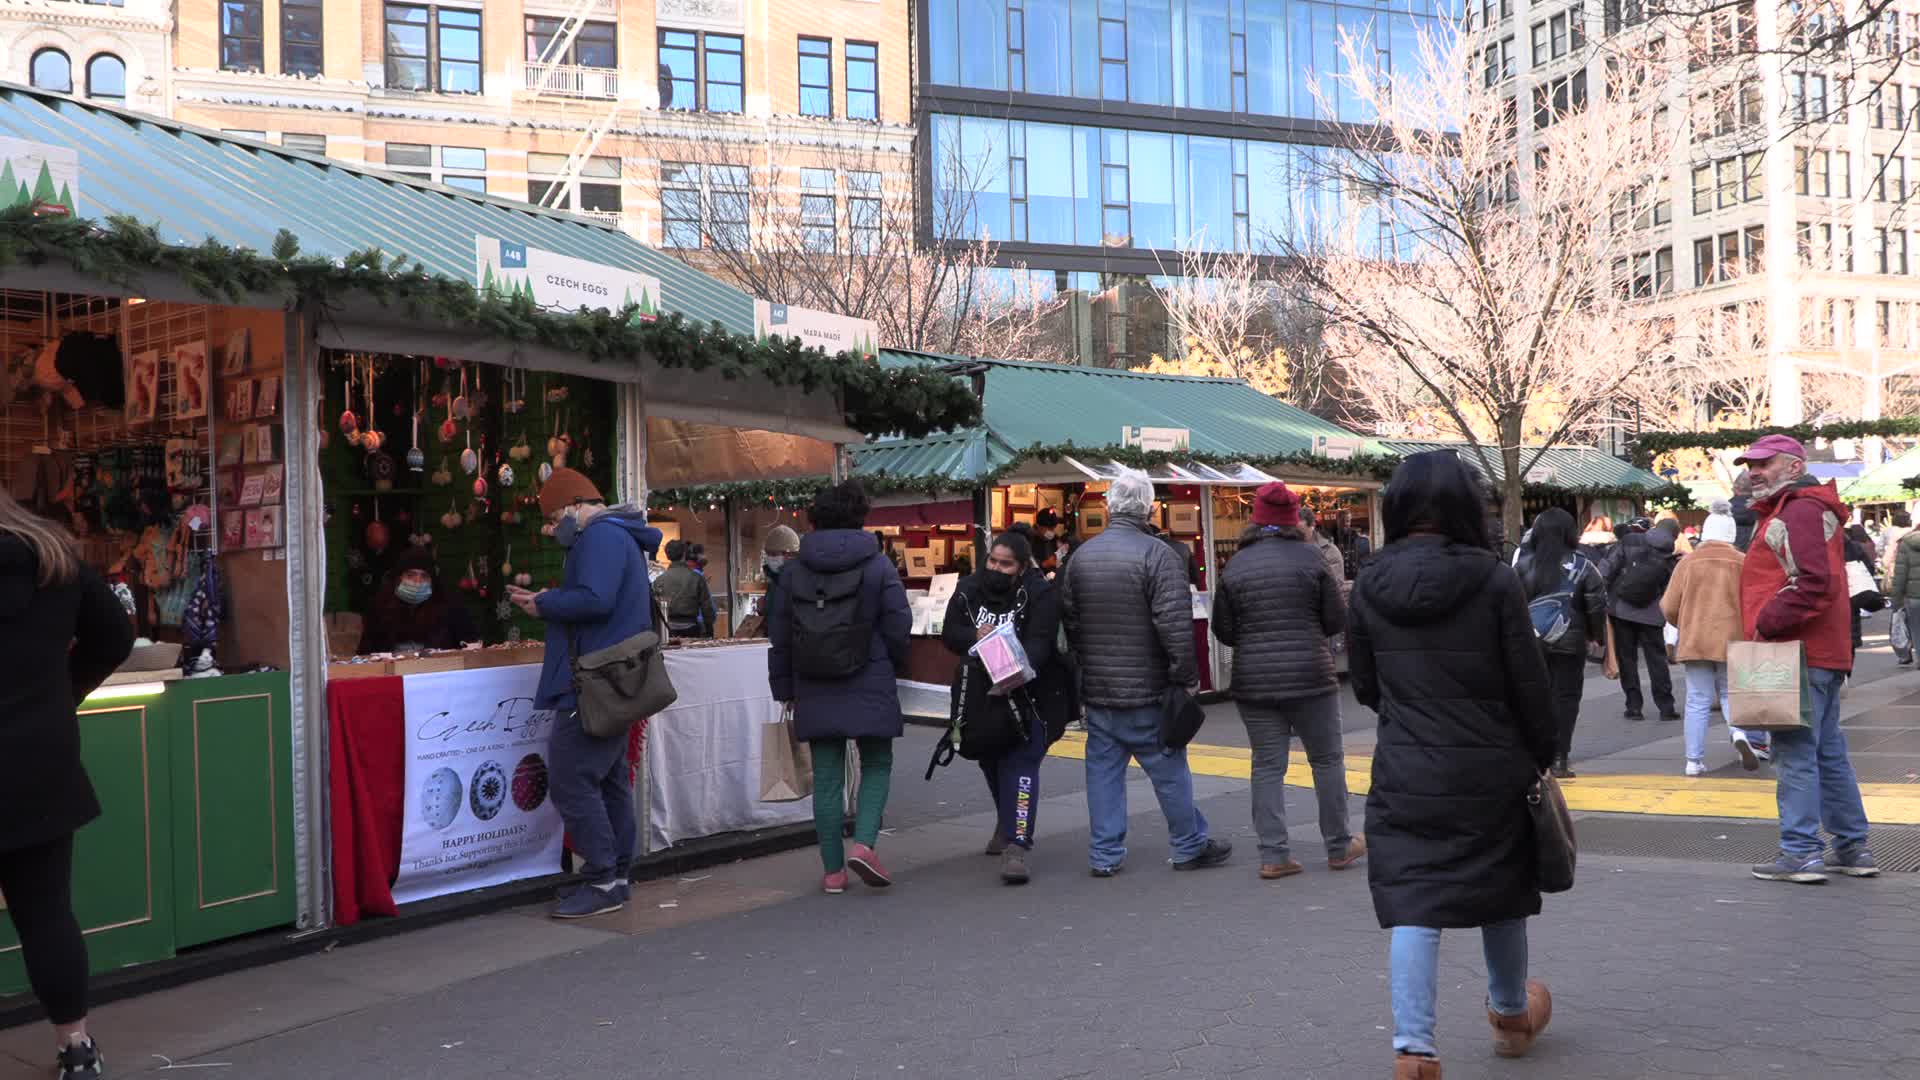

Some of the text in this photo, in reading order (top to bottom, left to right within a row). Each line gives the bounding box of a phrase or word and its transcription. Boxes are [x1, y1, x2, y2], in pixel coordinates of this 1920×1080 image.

[546, 274, 609, 297] CZECH EGGS
[803, 328, 841, 342] MARA MADE
[417, 707, 497, 741] Czech
[416, 751, 435, 761] HAND
[442, 835, 475, 849] HAPPY
[413, 855, 443, 870] Thanks
[445, 854, 457, 863] for
[459, 843, 502, 860] Supporting
